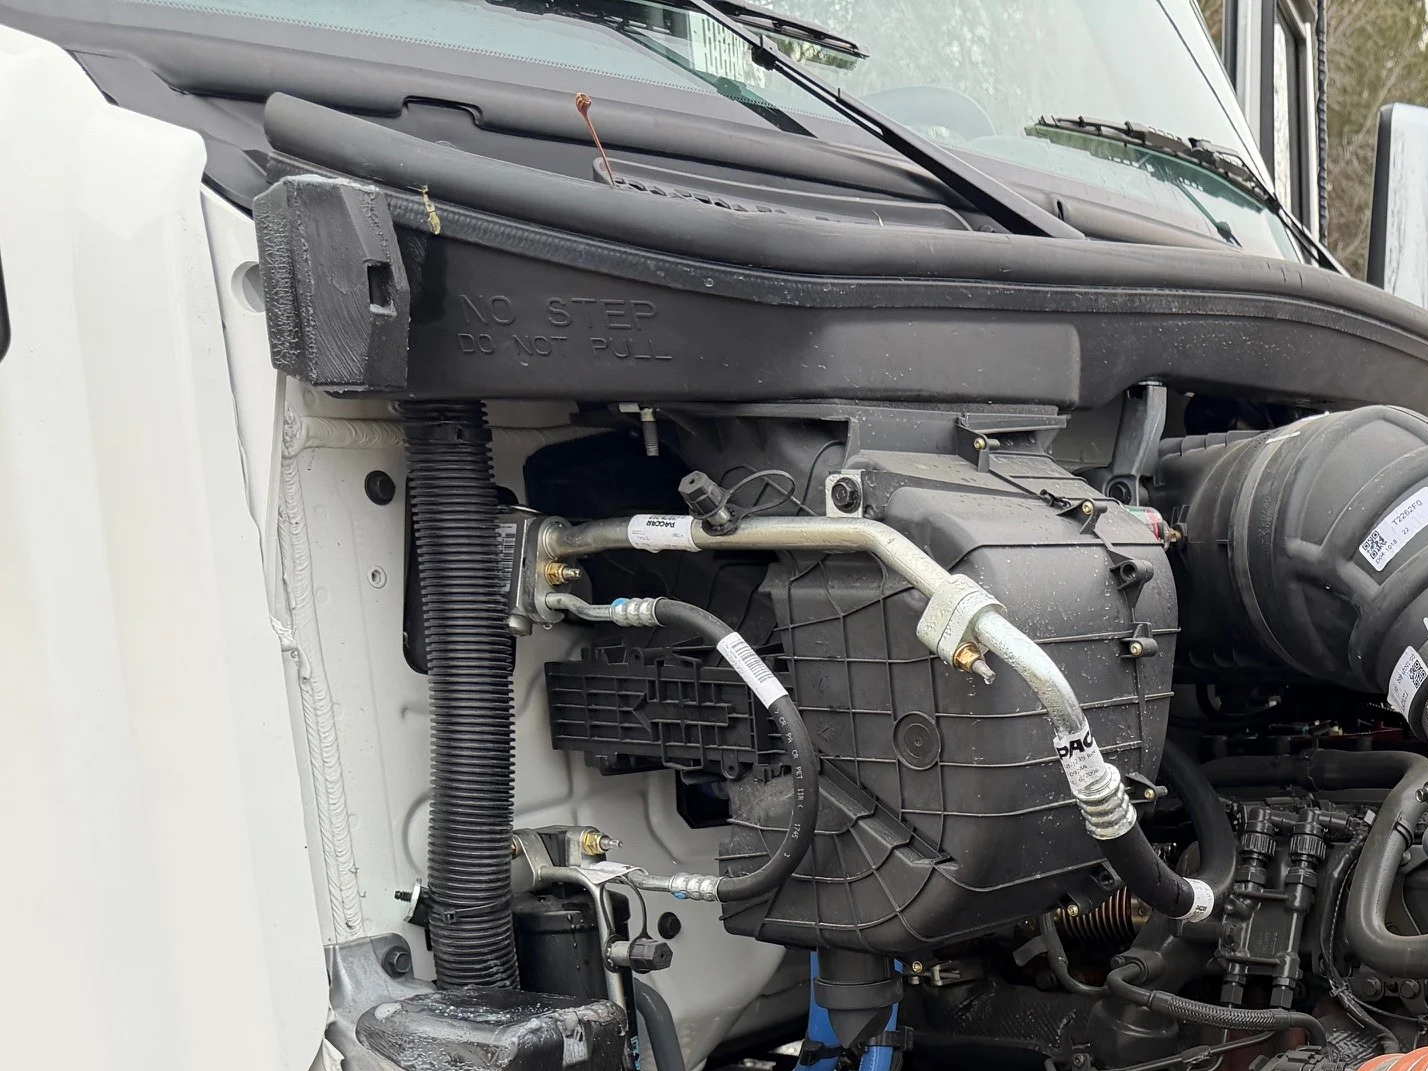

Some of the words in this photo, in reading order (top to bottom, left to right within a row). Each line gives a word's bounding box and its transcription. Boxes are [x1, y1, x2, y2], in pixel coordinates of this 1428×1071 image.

[460, 294, 514, 325] NO
[547, 297, 657, 330] STEP
[458, 333, 495, 354] DO
[513, 335, 567, 357] NOT
[590, 337, 672, 359] PULL
[1392, 500, 1422, 525] T2262F0
